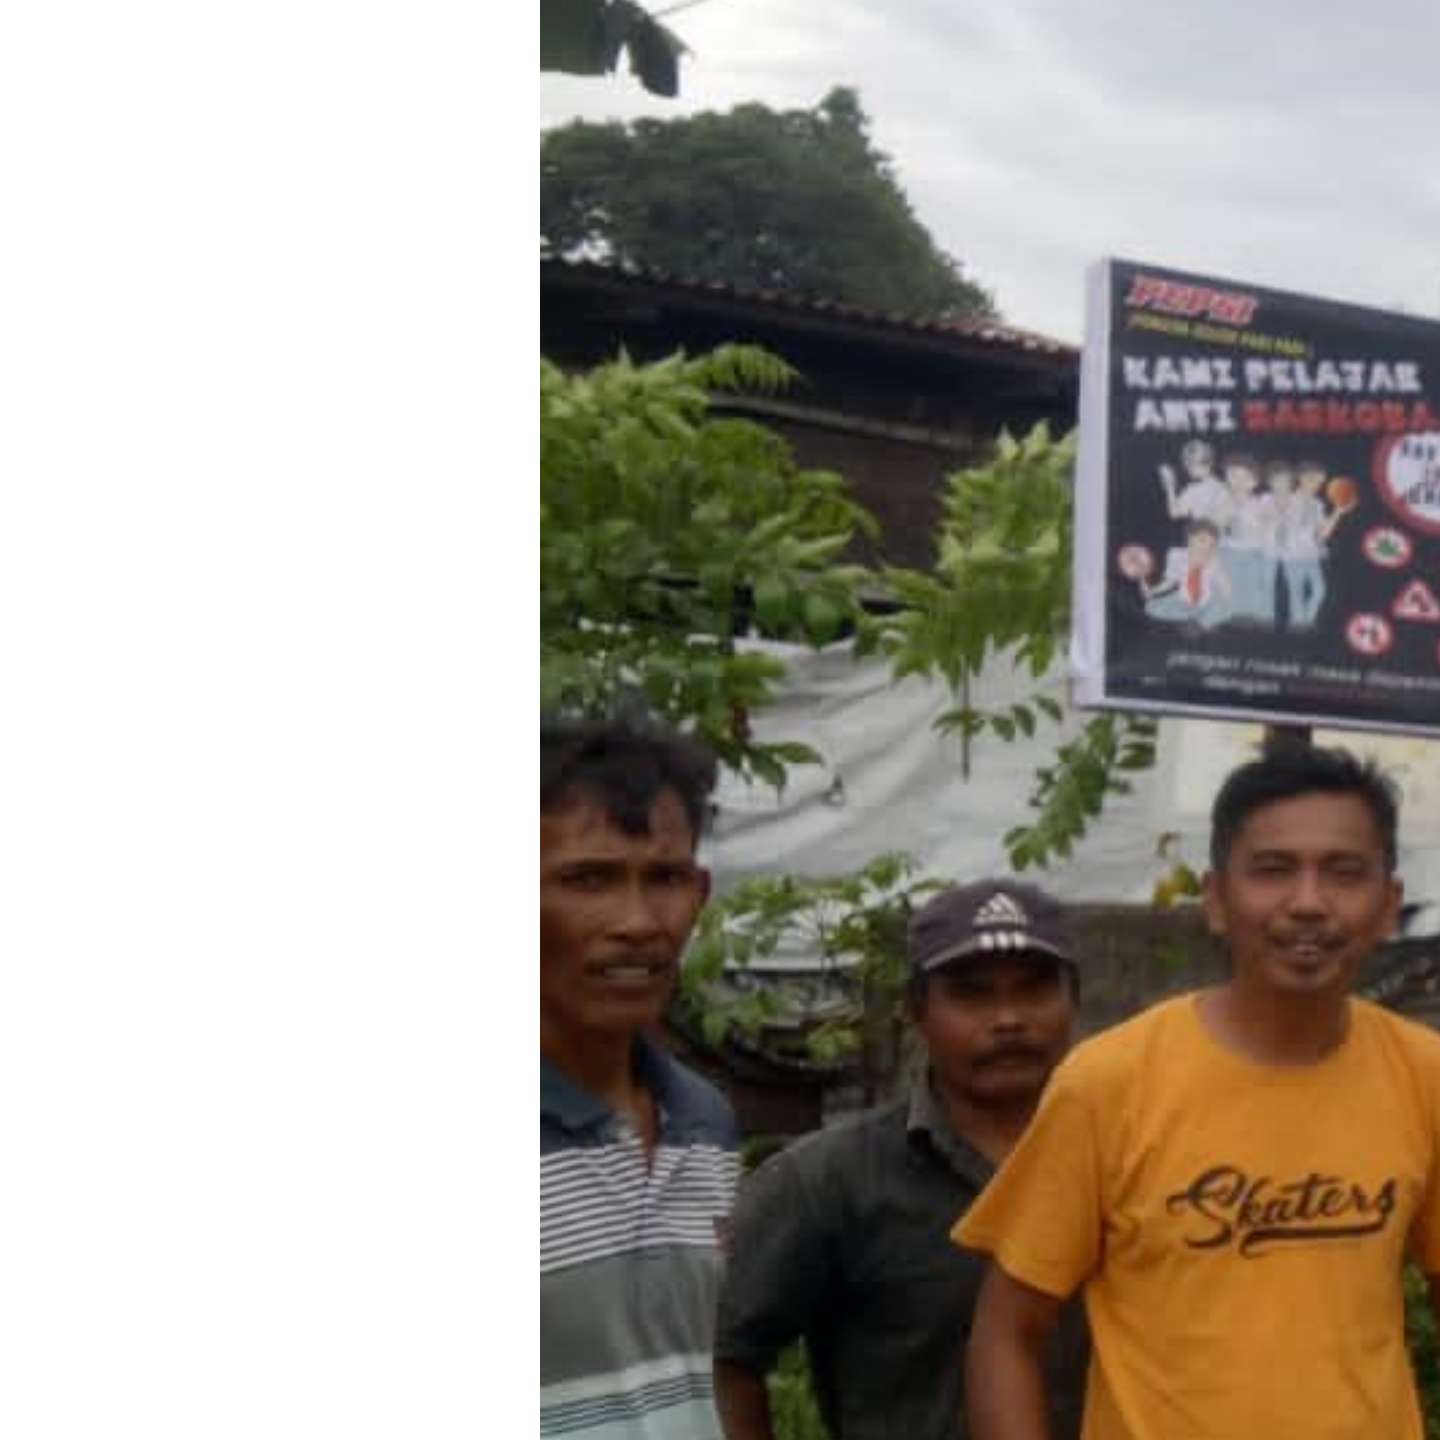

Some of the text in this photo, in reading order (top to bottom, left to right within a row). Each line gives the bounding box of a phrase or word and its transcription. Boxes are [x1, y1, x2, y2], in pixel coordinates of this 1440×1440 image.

[1122, 357, 1237, 391] KAMI
[1134, 399, 1237, 432] ANTI
[1166, 1165, 1398, 1259] Skaters
